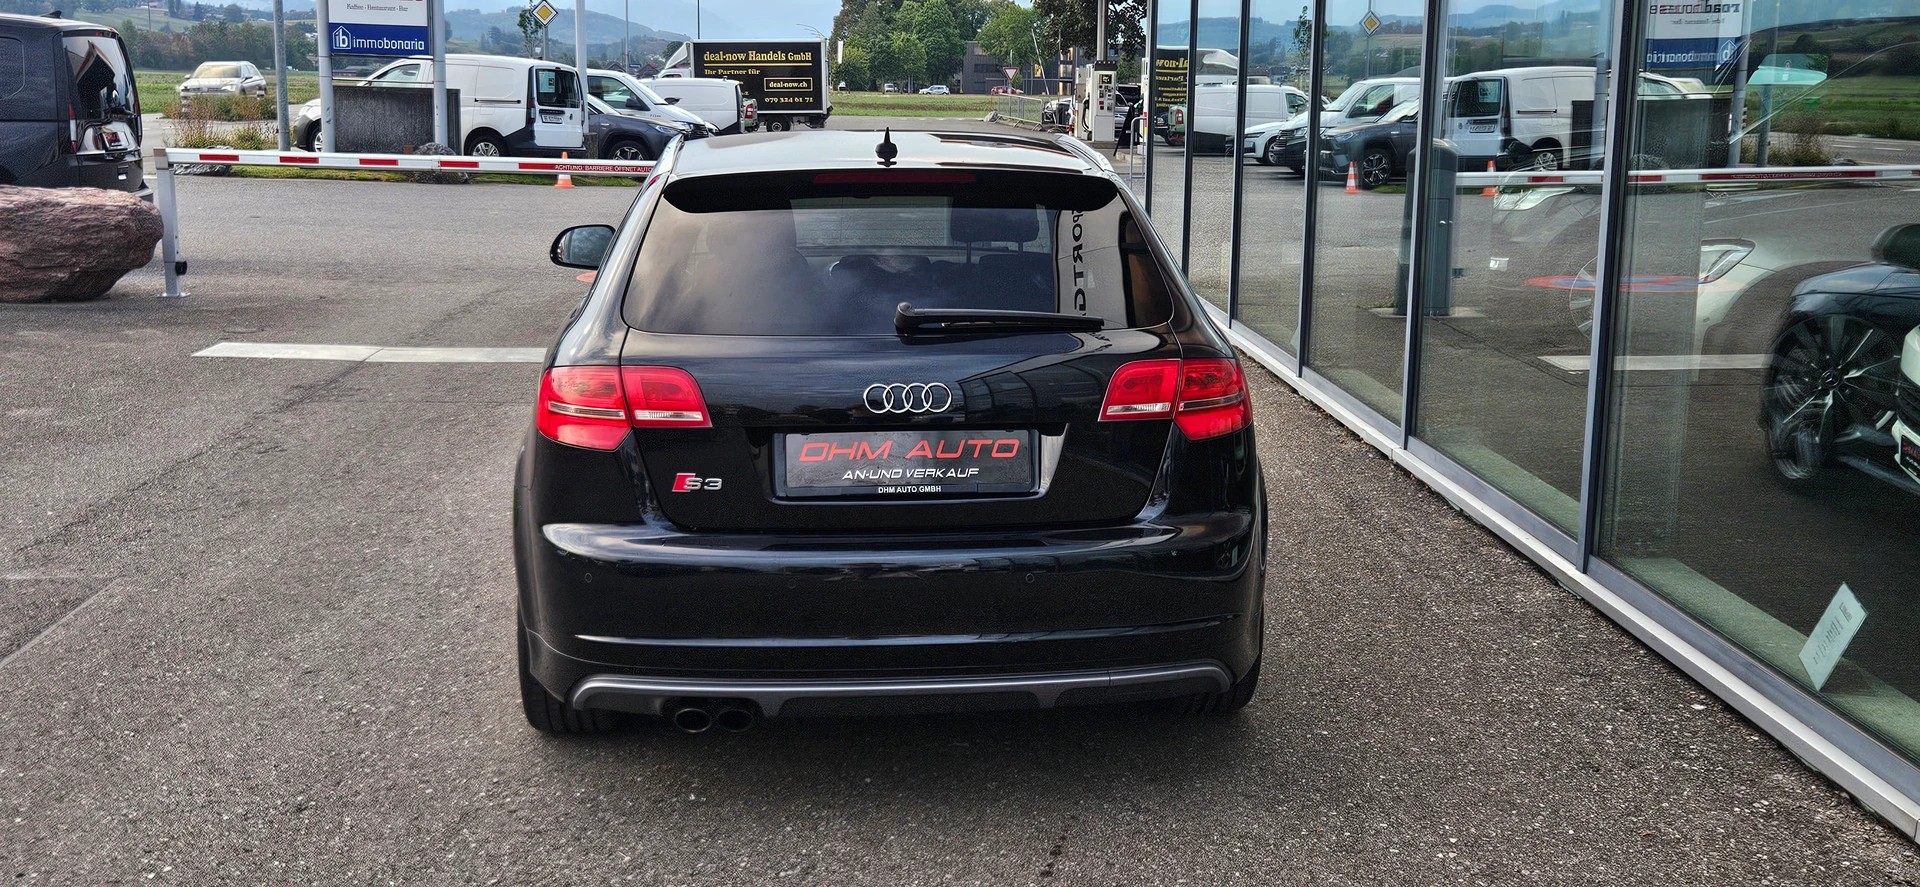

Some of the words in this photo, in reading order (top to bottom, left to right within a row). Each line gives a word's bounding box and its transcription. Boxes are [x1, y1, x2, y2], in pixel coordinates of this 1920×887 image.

[353, 36, 425, 50] immobonaria
[703, 51, 747, 61] deal-now
[748, 50, 786, 61] Handels
[787, 52, 812, 61] GmbH
[585, 164, 613, 172] BARRIERE
[800, 440, 893, 462] DHM
[904, 438, 1020, 459] AUTO
[842, 468, 904, 480] AN-UND
[905, 467, 979, 479] VERKAUF
[877, 486, 896, 494] DHM
[918, 485, 942, 493] GMBH
